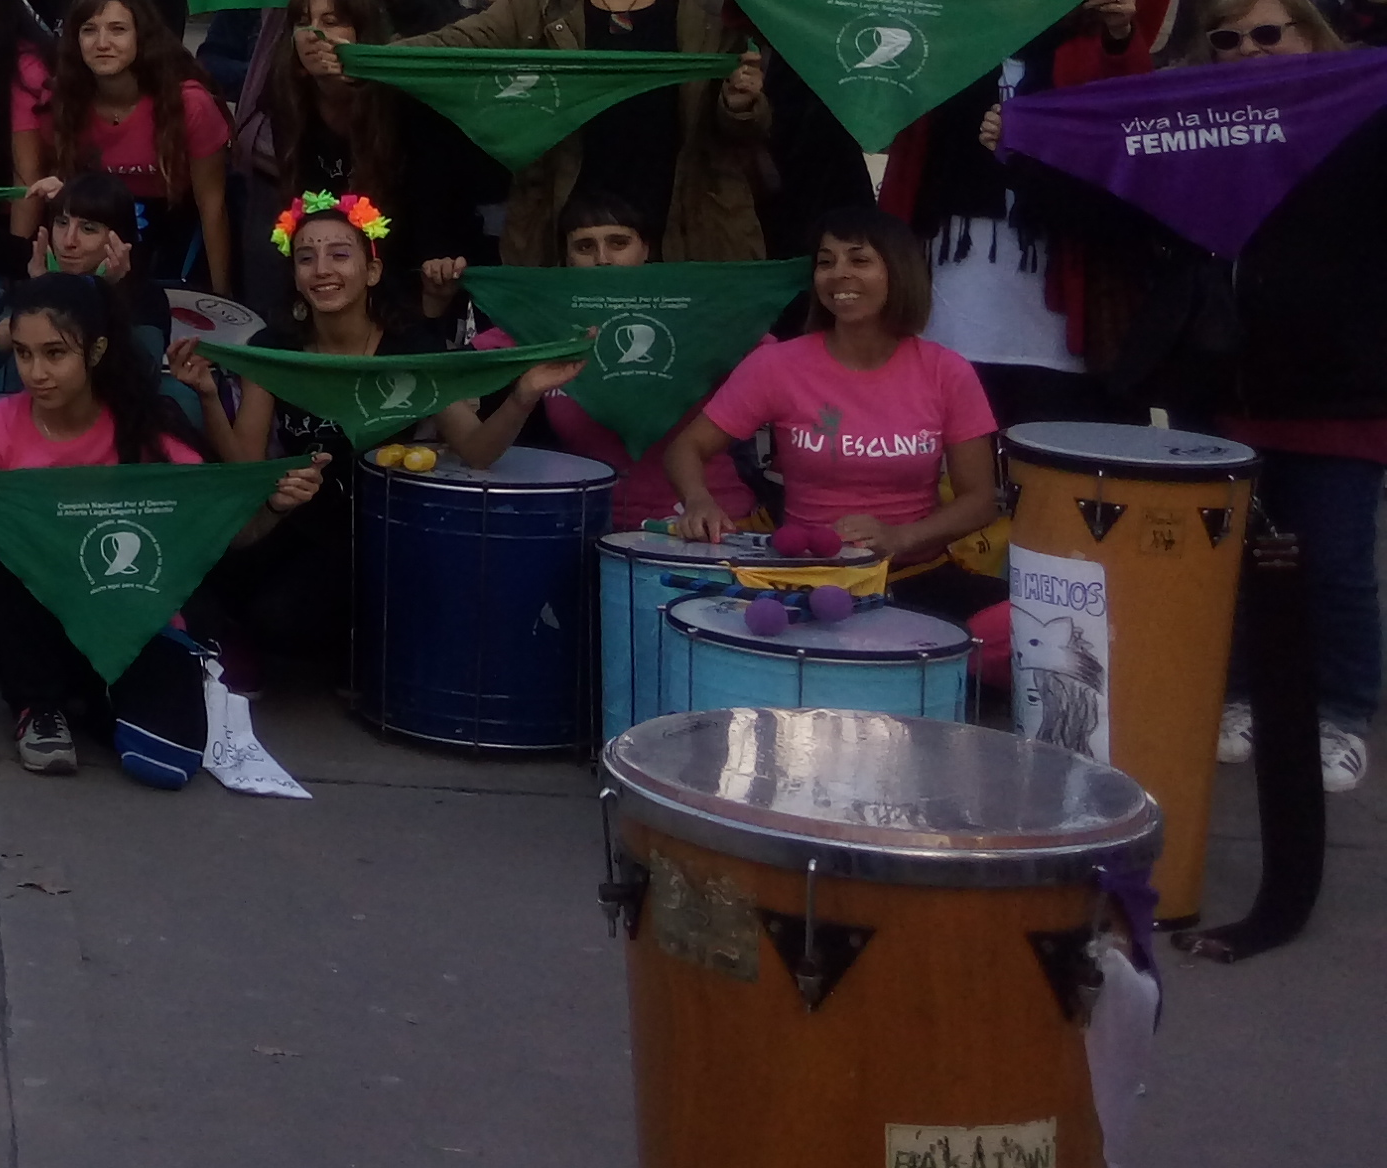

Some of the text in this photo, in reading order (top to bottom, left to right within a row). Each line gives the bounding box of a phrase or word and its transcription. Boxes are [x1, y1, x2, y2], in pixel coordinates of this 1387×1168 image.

[1121, 104, 1280, 134] viva la lucha
[1125, 123, 1287, 156] FEMINISTA
[791, 427, 825, 452] SIN
[1024, 572, 1106, 617] MENOS
